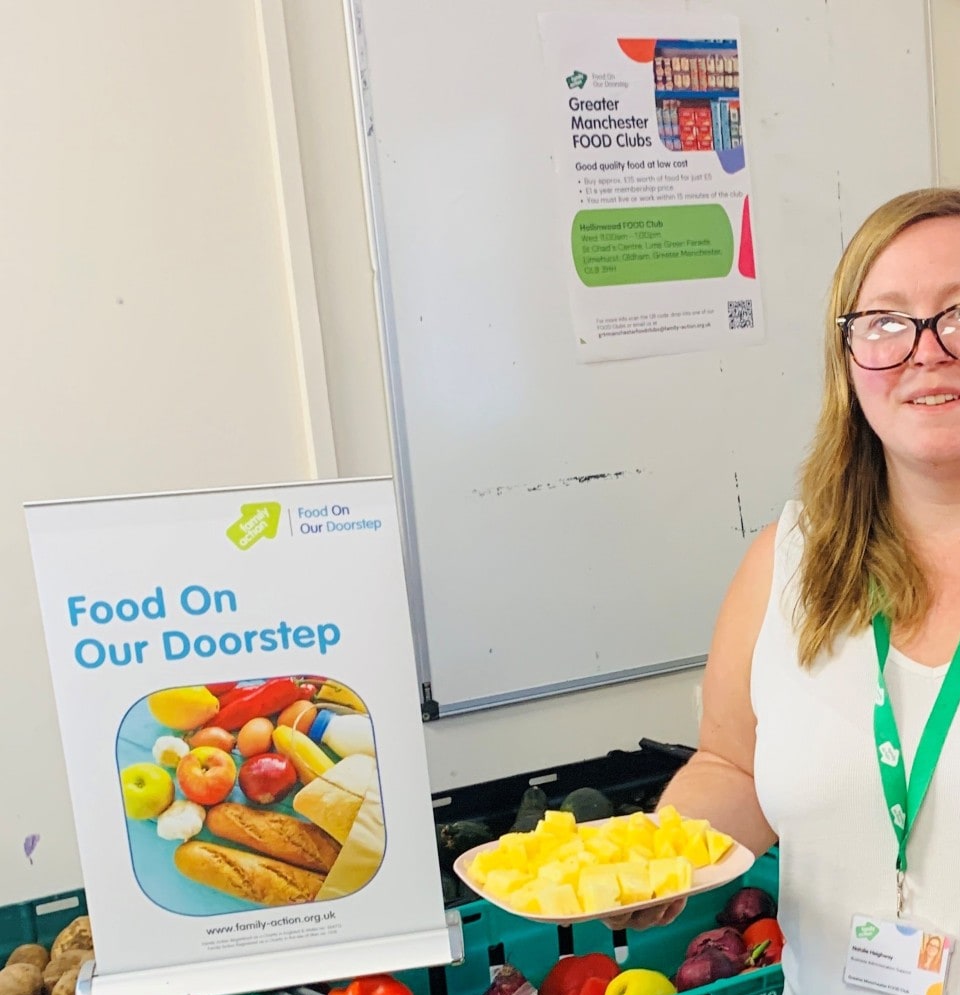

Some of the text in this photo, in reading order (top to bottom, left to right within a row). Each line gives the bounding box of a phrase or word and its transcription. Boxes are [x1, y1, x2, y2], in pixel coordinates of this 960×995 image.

[568, 97, 620, 111] Greater
[571, 114, 649, 130] Manchester
[572, 132, 652, 149] FOOD Clubs
[575, 159, 688, 171] Good quality food at low cost
[636, 175, 655, 183] worth
[664, 174, 679, 182] food
[614, 185, 656, 194] membership
[657, 184, 674, 193] price
[639, 194, 654, 202] work
[685, 192, 709, 200] minutes
[623, 221, 645, 230] FOOD
[646, 220, 664, 229] Club
[298, 504, 350, 519] Food On
[239, 507, 270, 534] family
[300, 518, 382, 534] Our Doorstep
[239, 520, 268, 547] action
[68, 584, 238, 627] Food On
[74, 619, 342, 670] Our Doorstep
[206, 910, 336, 936] www.family-action.org.uk
